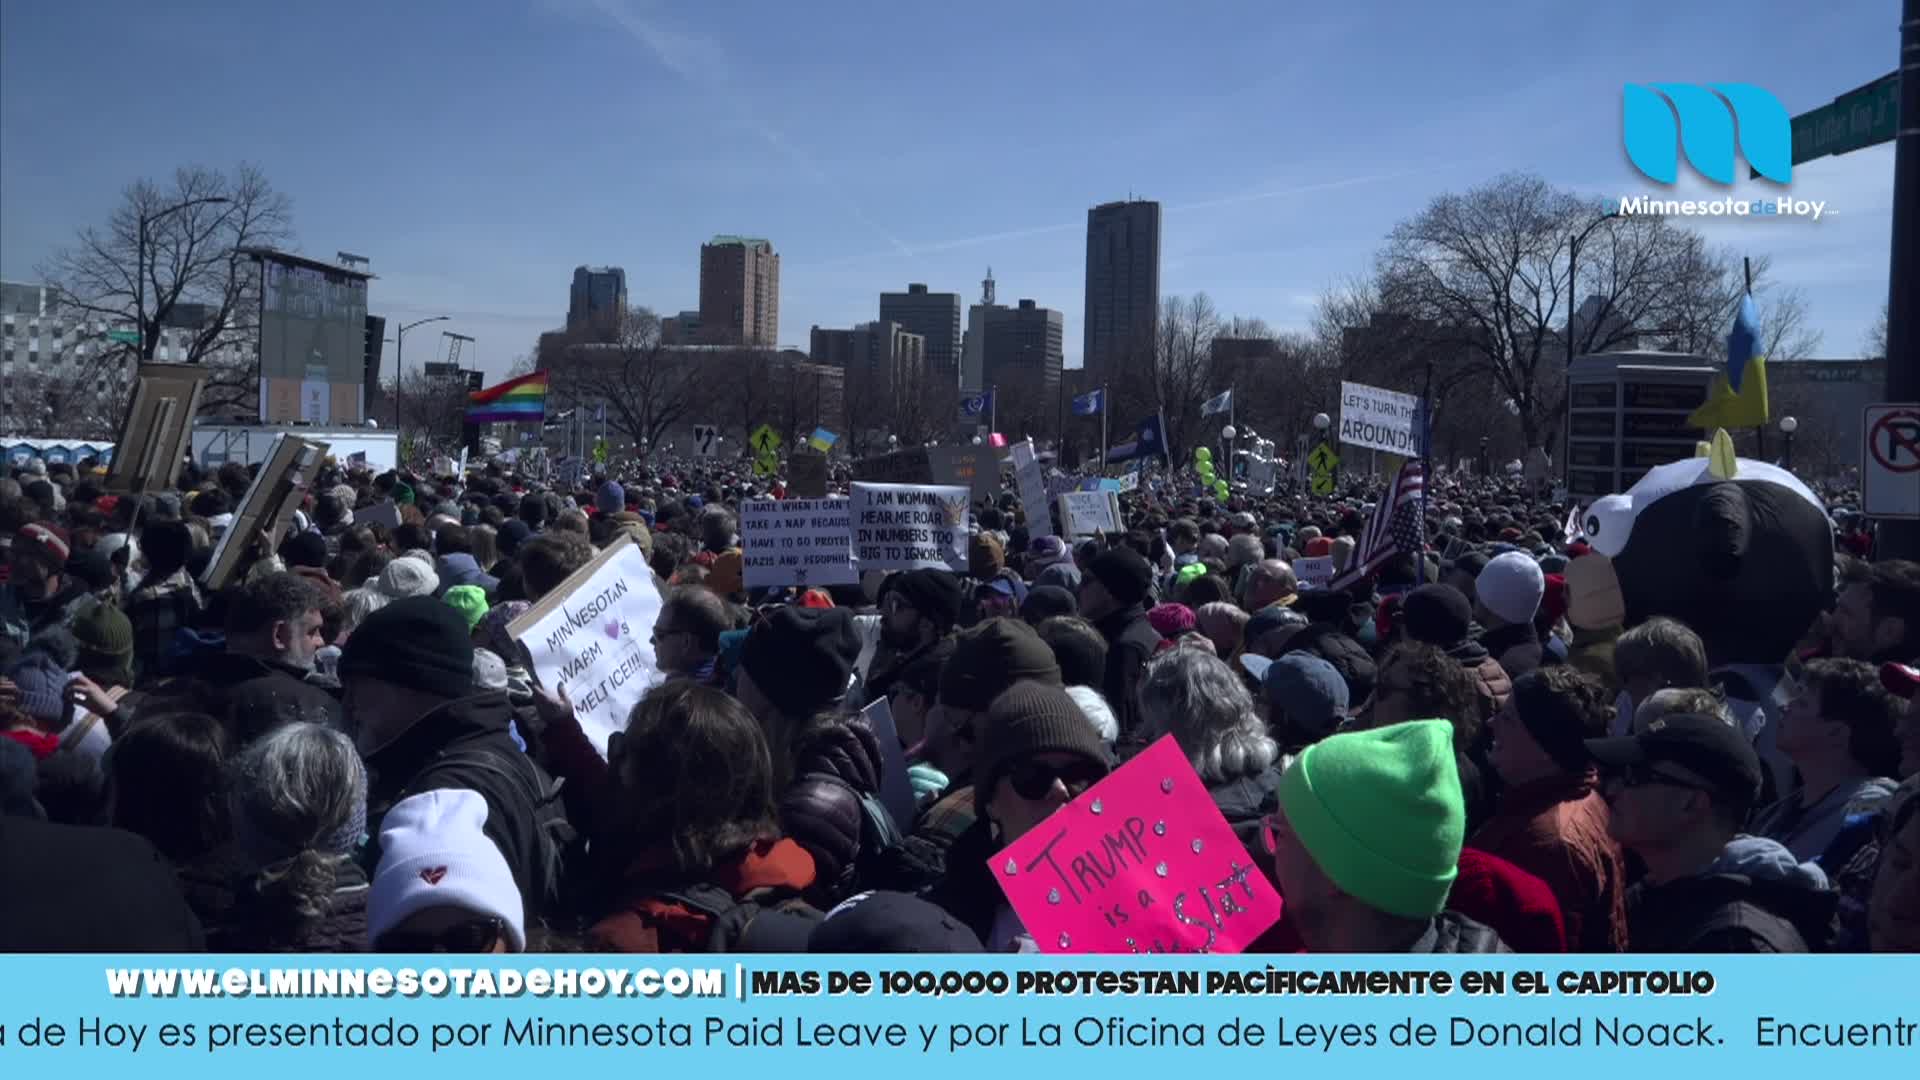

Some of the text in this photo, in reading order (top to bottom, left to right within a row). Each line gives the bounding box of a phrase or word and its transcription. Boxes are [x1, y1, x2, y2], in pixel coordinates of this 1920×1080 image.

[1343, 394, 1370, 411] LET'S
[1372, 399, 1397, 416] TURN
[867, 491, 937, 505] I AM WOMAN
[744, 503, 748, 512] I
[753, 501, 777, 512] HATE
[782, 501, 811, 512] WHEN
[746, 520, 769, 530] TAKE
[774, 519, 781, 528] A
[786, 519, 805, 528] NAP
[861, 511, 943, 525] HEAR ME ROAR
[751, 537, 774, 548] HAVE
[782, 537, 793, 548] TO
[797, 536, 810, 546] GO
[858, 528, 953, 545] IN NUMBERS TOO
[861, 546, 880, 560] BIG
[886, 546, 900, 560] TO
[744, 556, 774, 567] NAZIS
[780, 555, 800, 565] AND
[545, 578, 629, 652] MINNESOTAN
[558, 641, 604, 685] WARM
[574, 650, 642, 721] MELT ICE!!!
[1137, 889, 1156, 908] a
